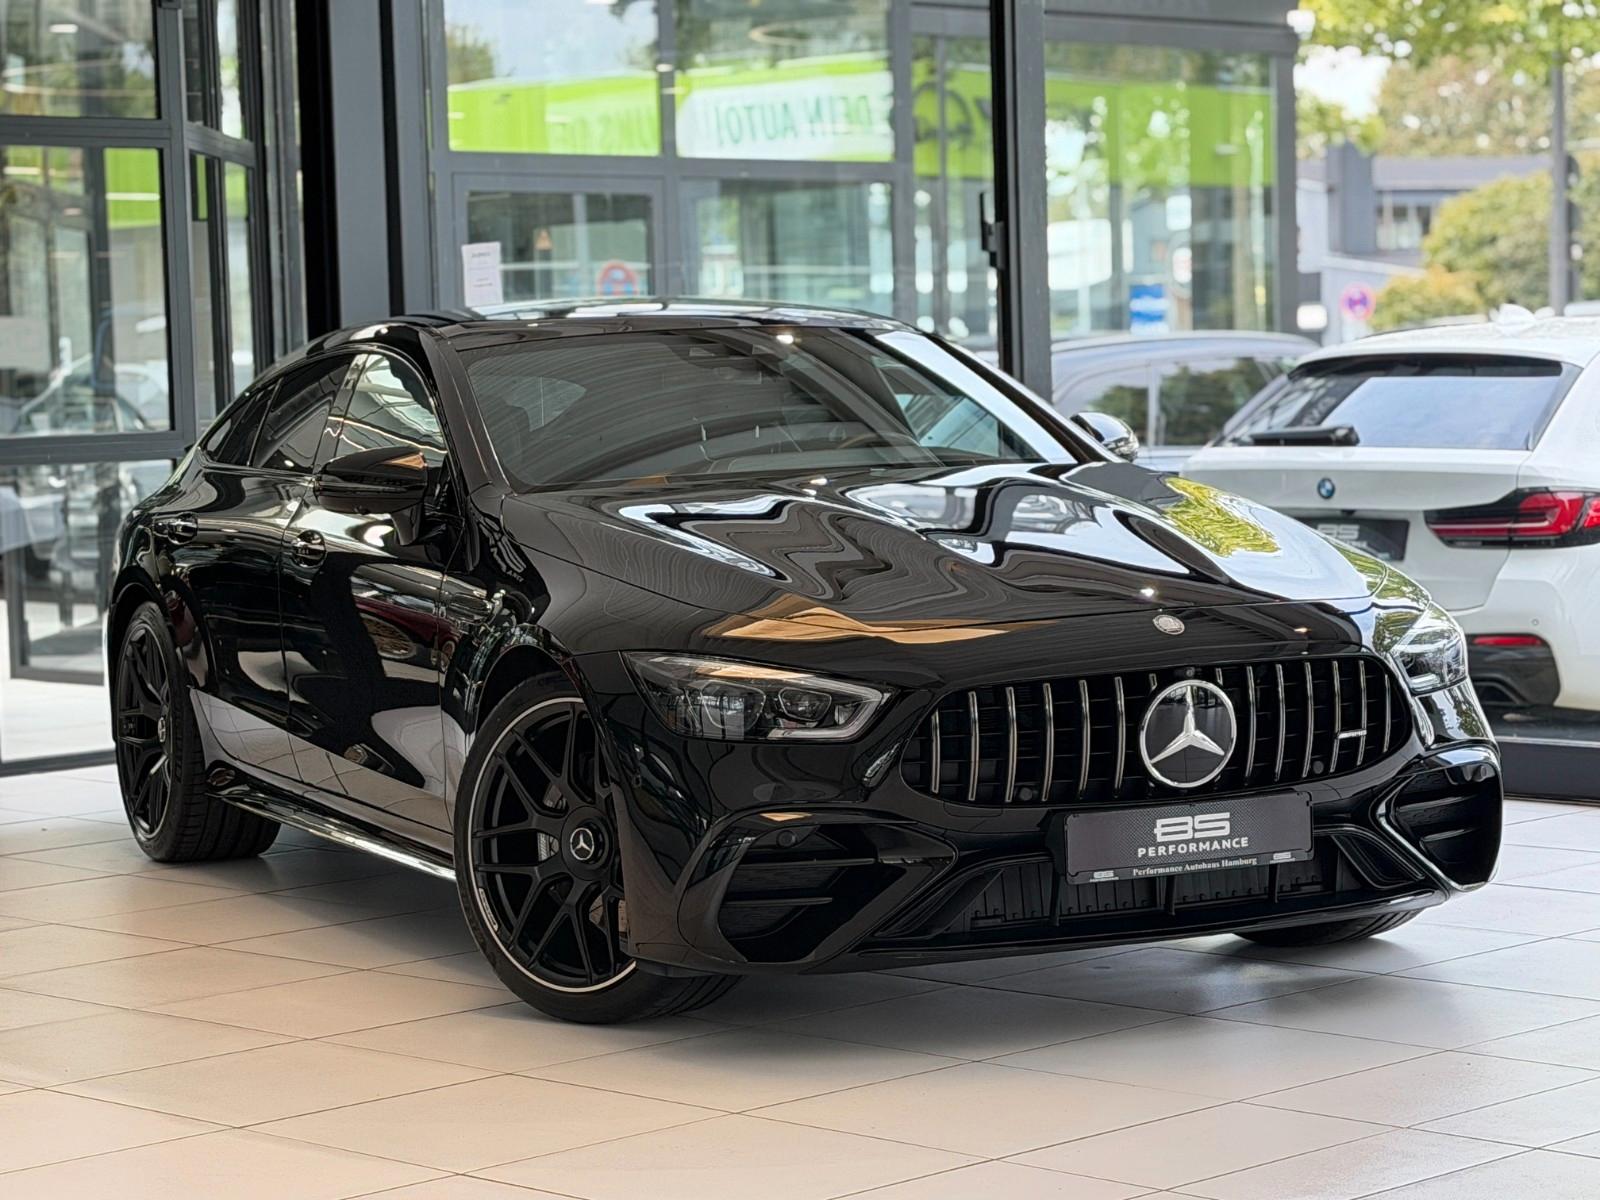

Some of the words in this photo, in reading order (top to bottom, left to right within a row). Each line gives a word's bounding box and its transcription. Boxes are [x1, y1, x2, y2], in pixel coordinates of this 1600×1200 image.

[1137, 837, 1249, 858] PERFORMANCE
[1133, 865, 1182, 876] Performance
[1184, 861, 1220, 871] Autohaus
[1221, 857, 1258, 867] Hamburg
